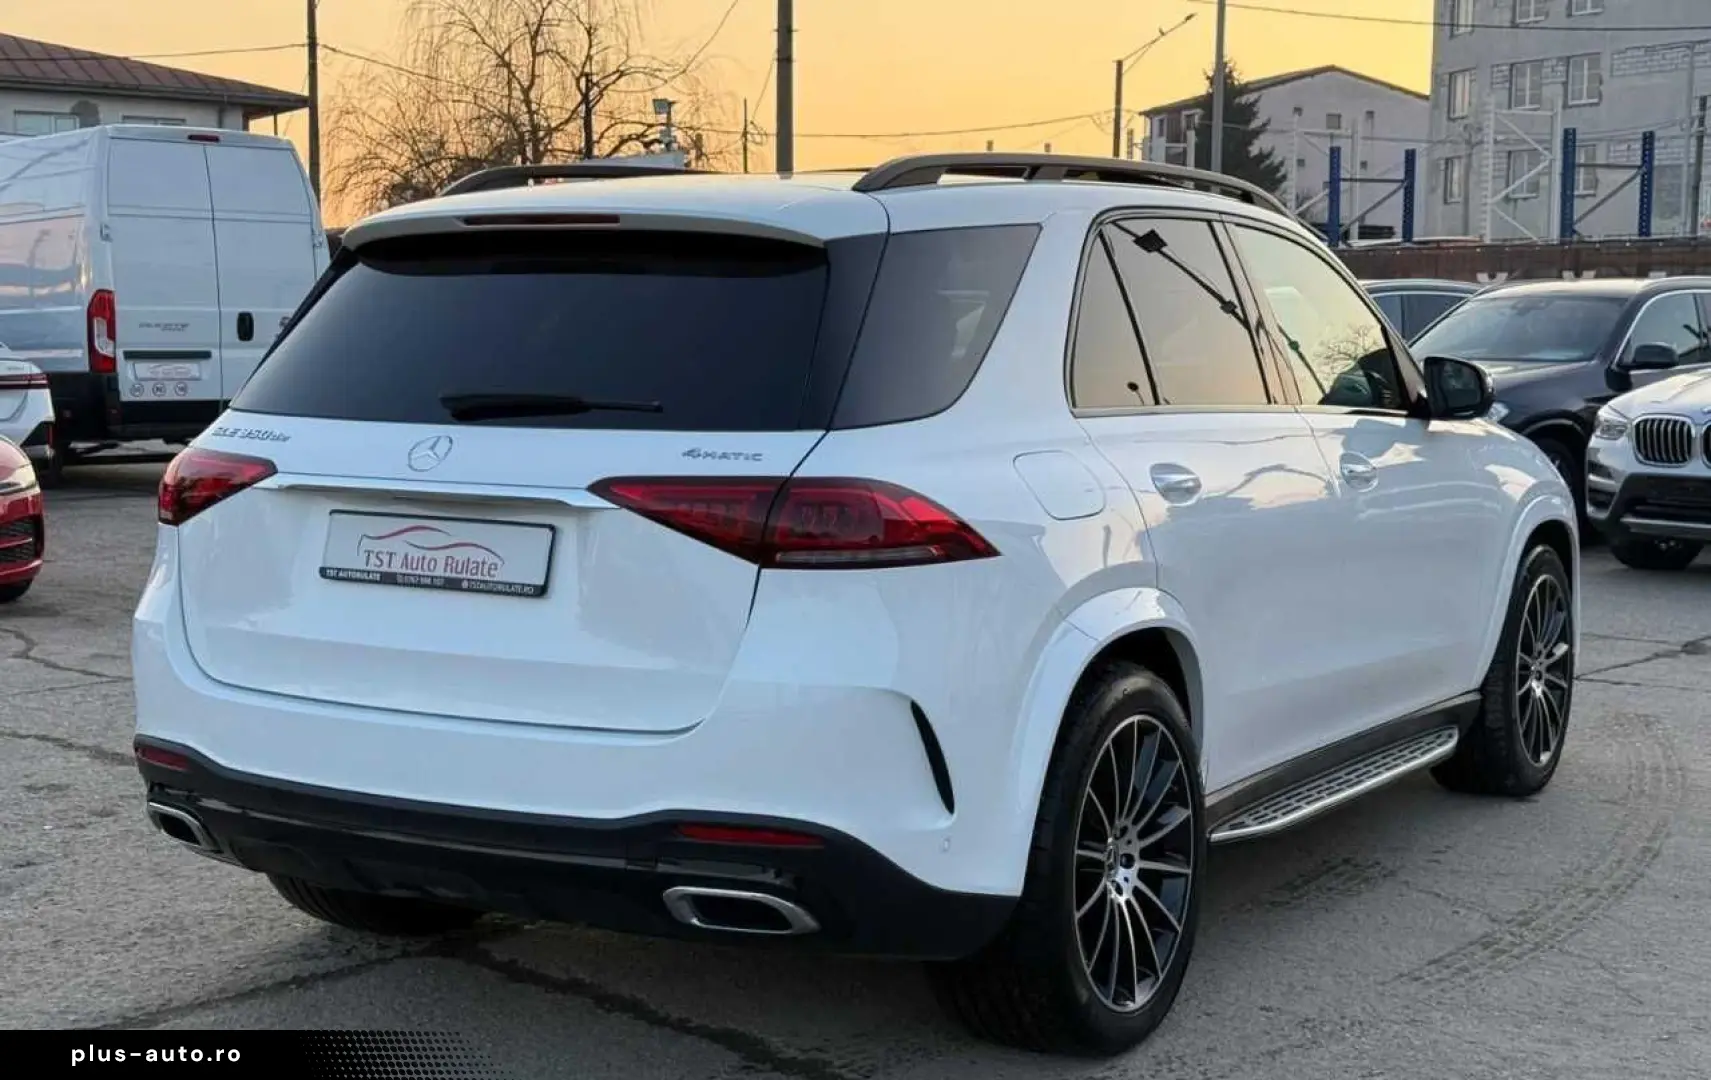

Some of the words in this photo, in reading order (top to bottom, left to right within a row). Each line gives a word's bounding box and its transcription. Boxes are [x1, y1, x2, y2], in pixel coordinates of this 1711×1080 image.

[681, 447, 763, 462] 4MATIC
[363, 549, 397, 568] TST
[400, 552, 438, 573] Auto
[443, 556, 499, 578] Rulate
